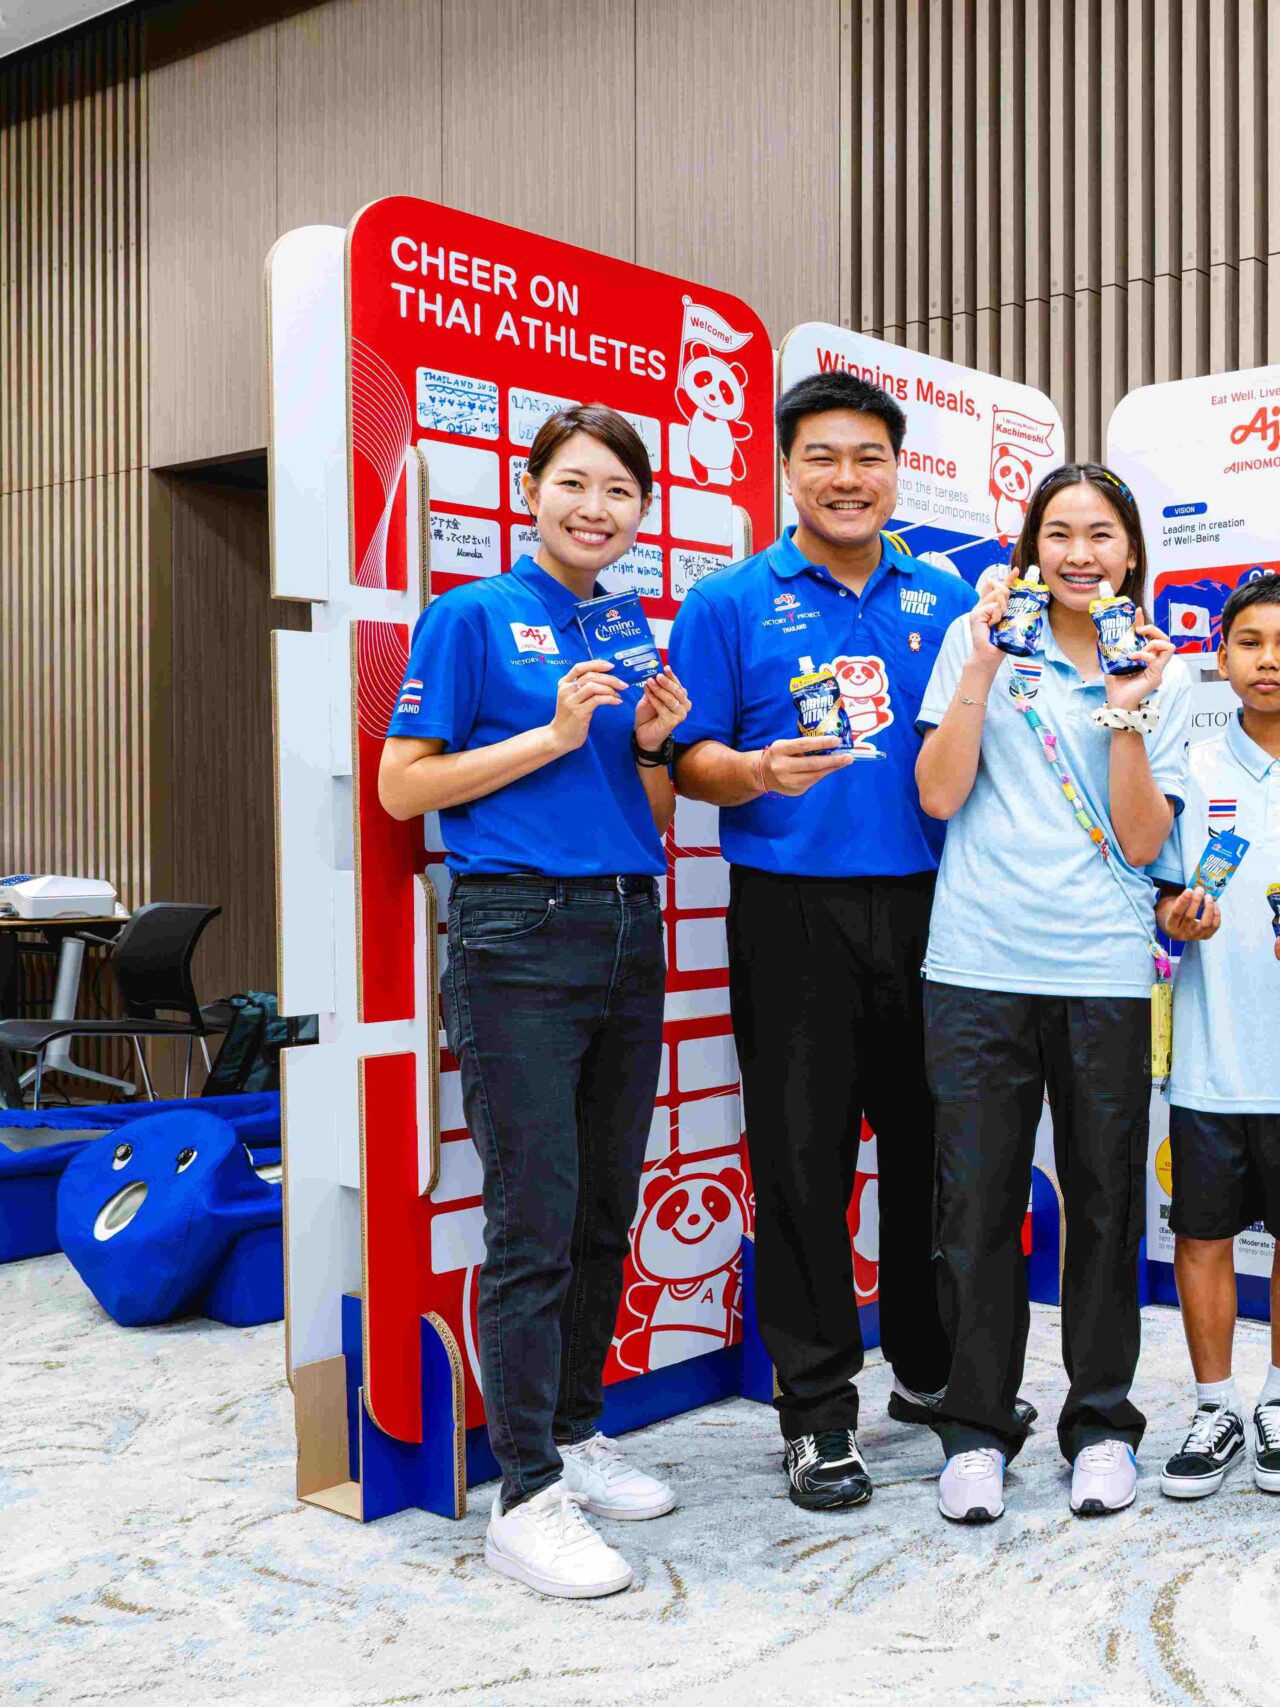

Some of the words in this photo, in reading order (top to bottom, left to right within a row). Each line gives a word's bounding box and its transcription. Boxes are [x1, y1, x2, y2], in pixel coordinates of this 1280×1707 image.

[390, 236, 518, 301] CHEER
[530, 275, 579, 316] ON
[390, 282, 481, 337] THAI
[495, 310, 666, 381] ATHLETES
[690, 316, 733, 345] Welcome!
[423, 371, 474, 390] THAILAND
[917, 377, 982, 421] Meals,
[1211, 395, 1227, 406] Eat
[996, 423, 1044, 444] Kachimeshi
[916, 481, 932, 495] the
[934, 484, 969, 504] targets
[907, 497, 930, 511] meal
[932, 502, 991, 525] components
[1174, 506, 1196, 515] VISION
[1163, 523, 1196, 536] Leading
[1199, 522, 1207, 531] in
[1209, 518, 1245, 530] creation
[1163, 537, 1172, 546] of
[1175, 532, 1220, 545] Well-Being
[900, 587, 937, 606] amino
[600, 619, 635, 633] Amino
[620, 627, 642, 639] Nite
[510, 658, 538, 666] VICTORY
[800, 694, 834, 713] amino
[701, 1287, 714, 1304] A
